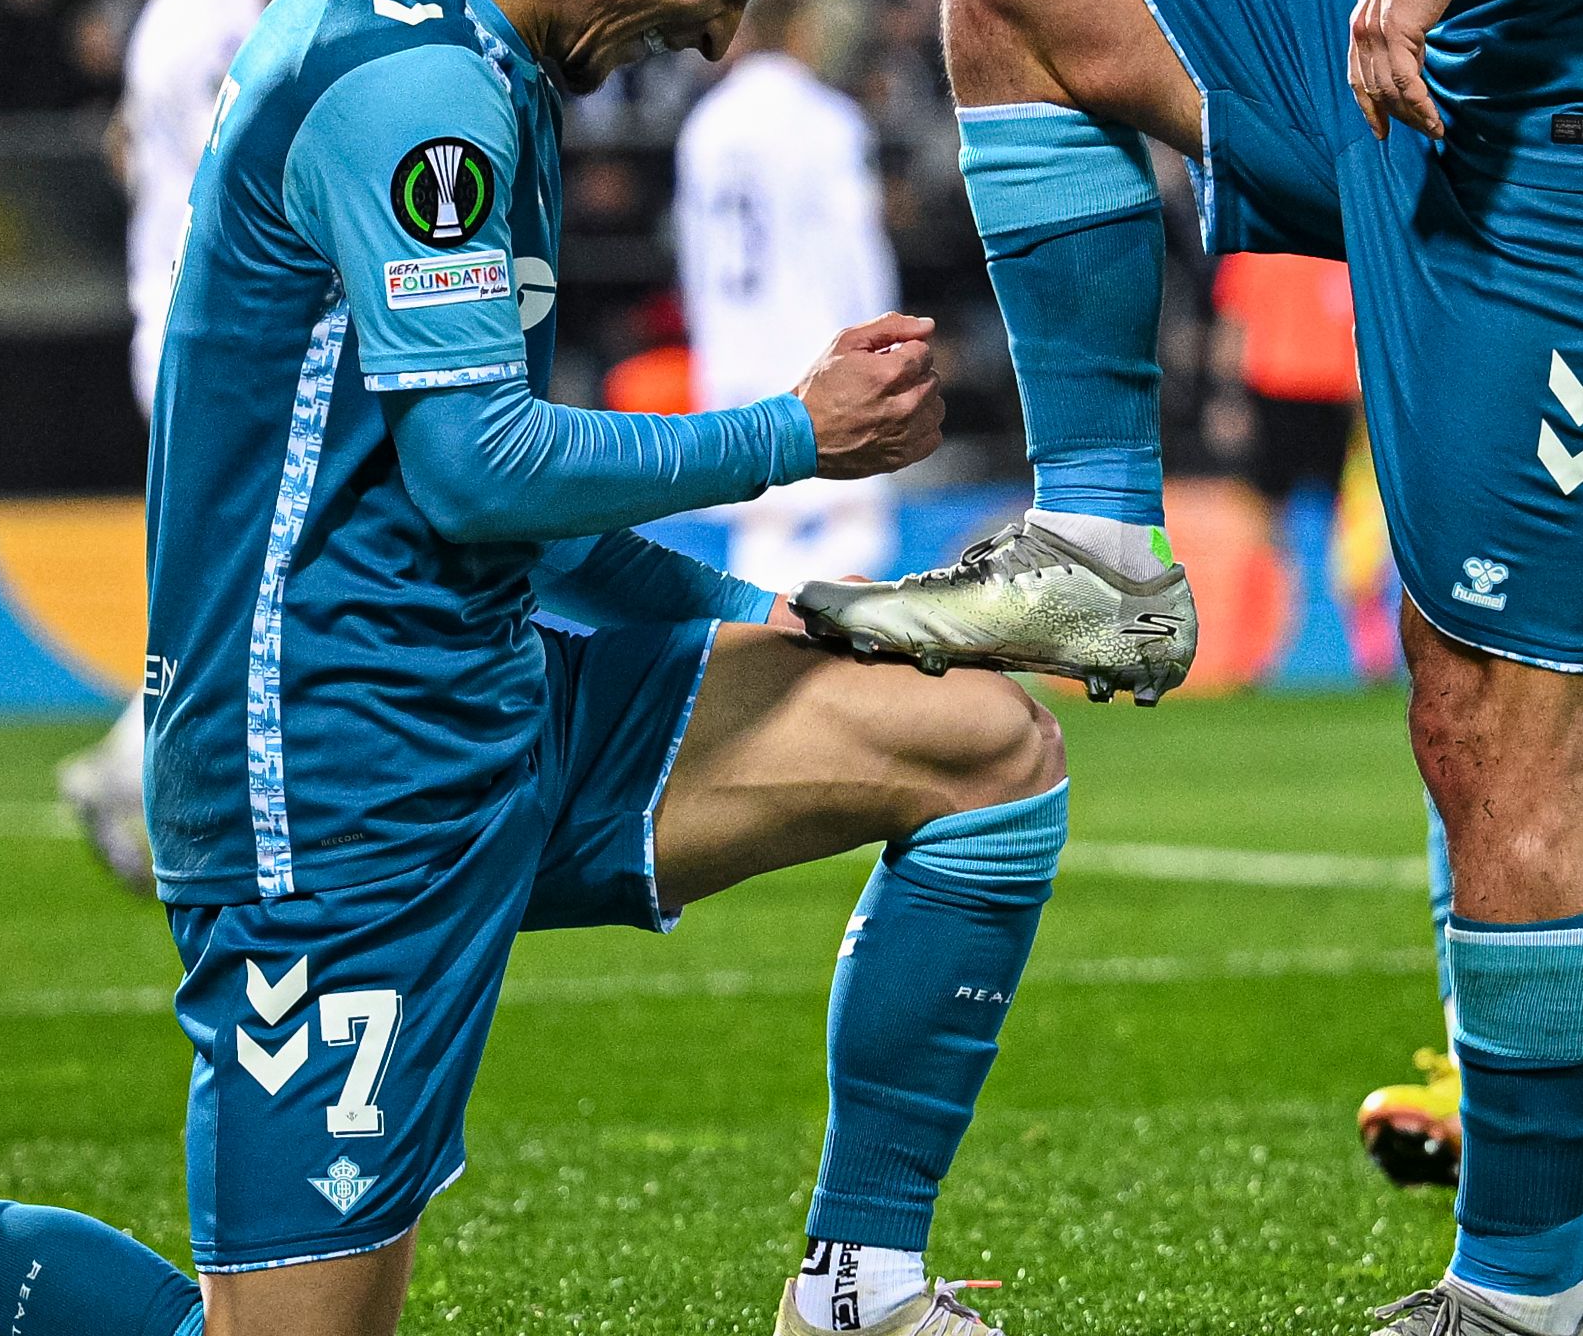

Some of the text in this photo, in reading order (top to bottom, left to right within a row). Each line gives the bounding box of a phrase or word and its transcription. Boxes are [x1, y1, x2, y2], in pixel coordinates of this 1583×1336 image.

[389, 263, 420, 276] UEFA
[1454, 584, 1506, 610] hummel
[318, 989, 404, 1139] 7
